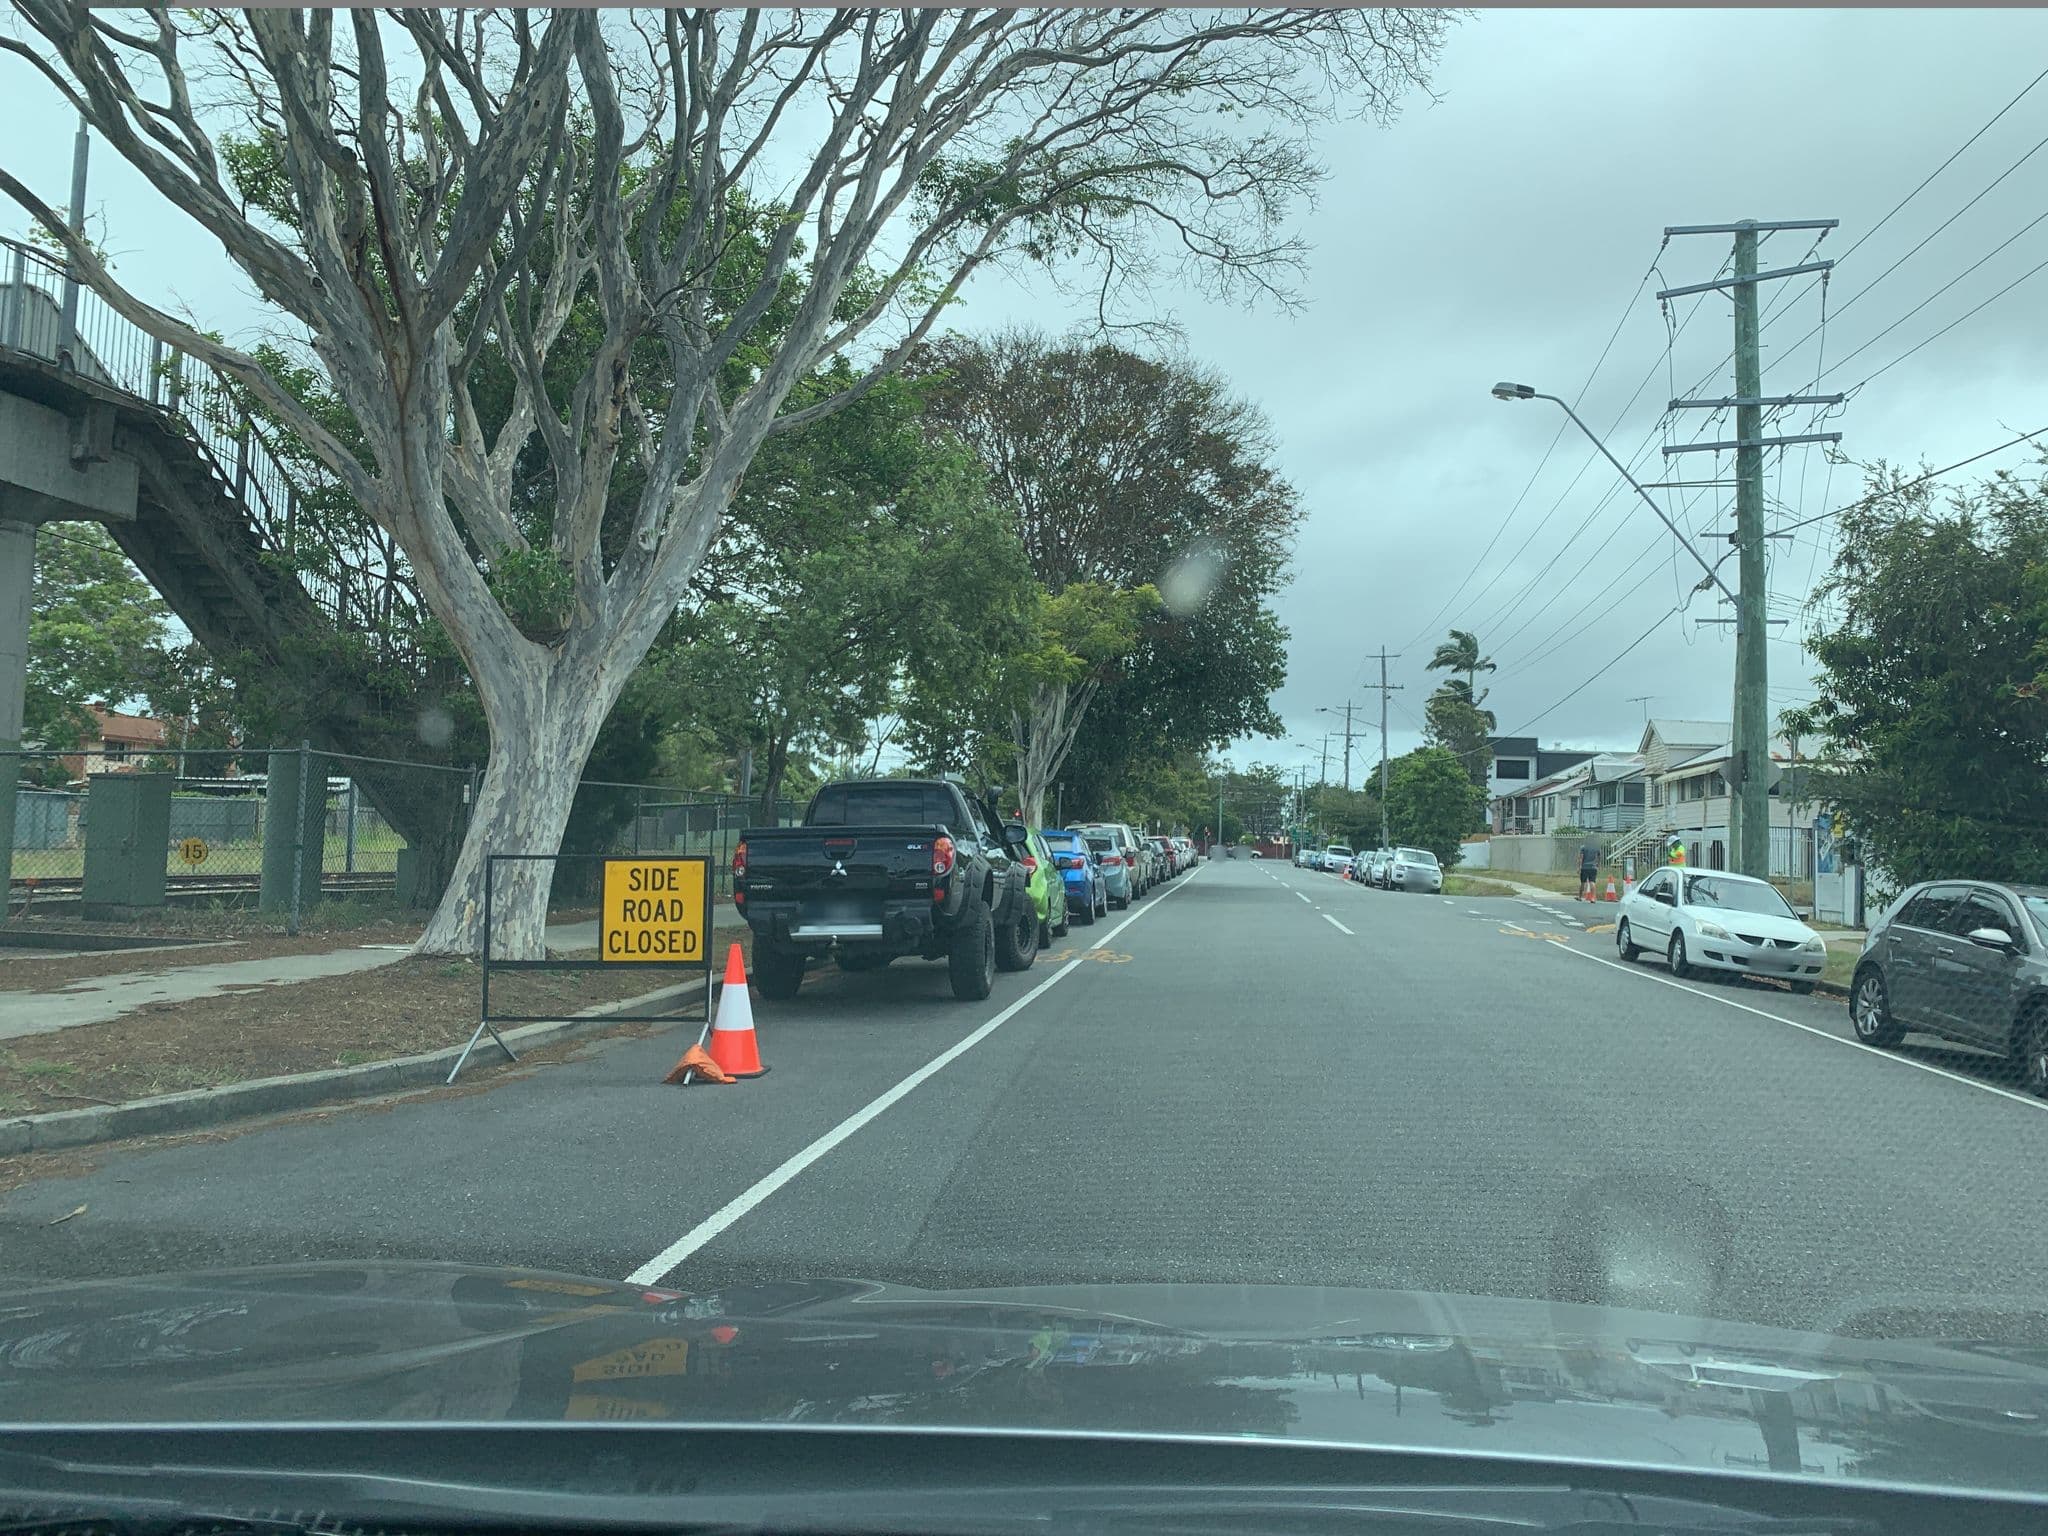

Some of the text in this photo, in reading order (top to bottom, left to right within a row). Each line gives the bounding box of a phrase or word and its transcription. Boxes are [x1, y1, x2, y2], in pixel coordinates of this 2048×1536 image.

[185, 844, 203, 859] 15
[628, 868, 680, 891] SIDE
[622, 899, 684, 923] ROAD
[608, 930, 697, 954] CLOSED
